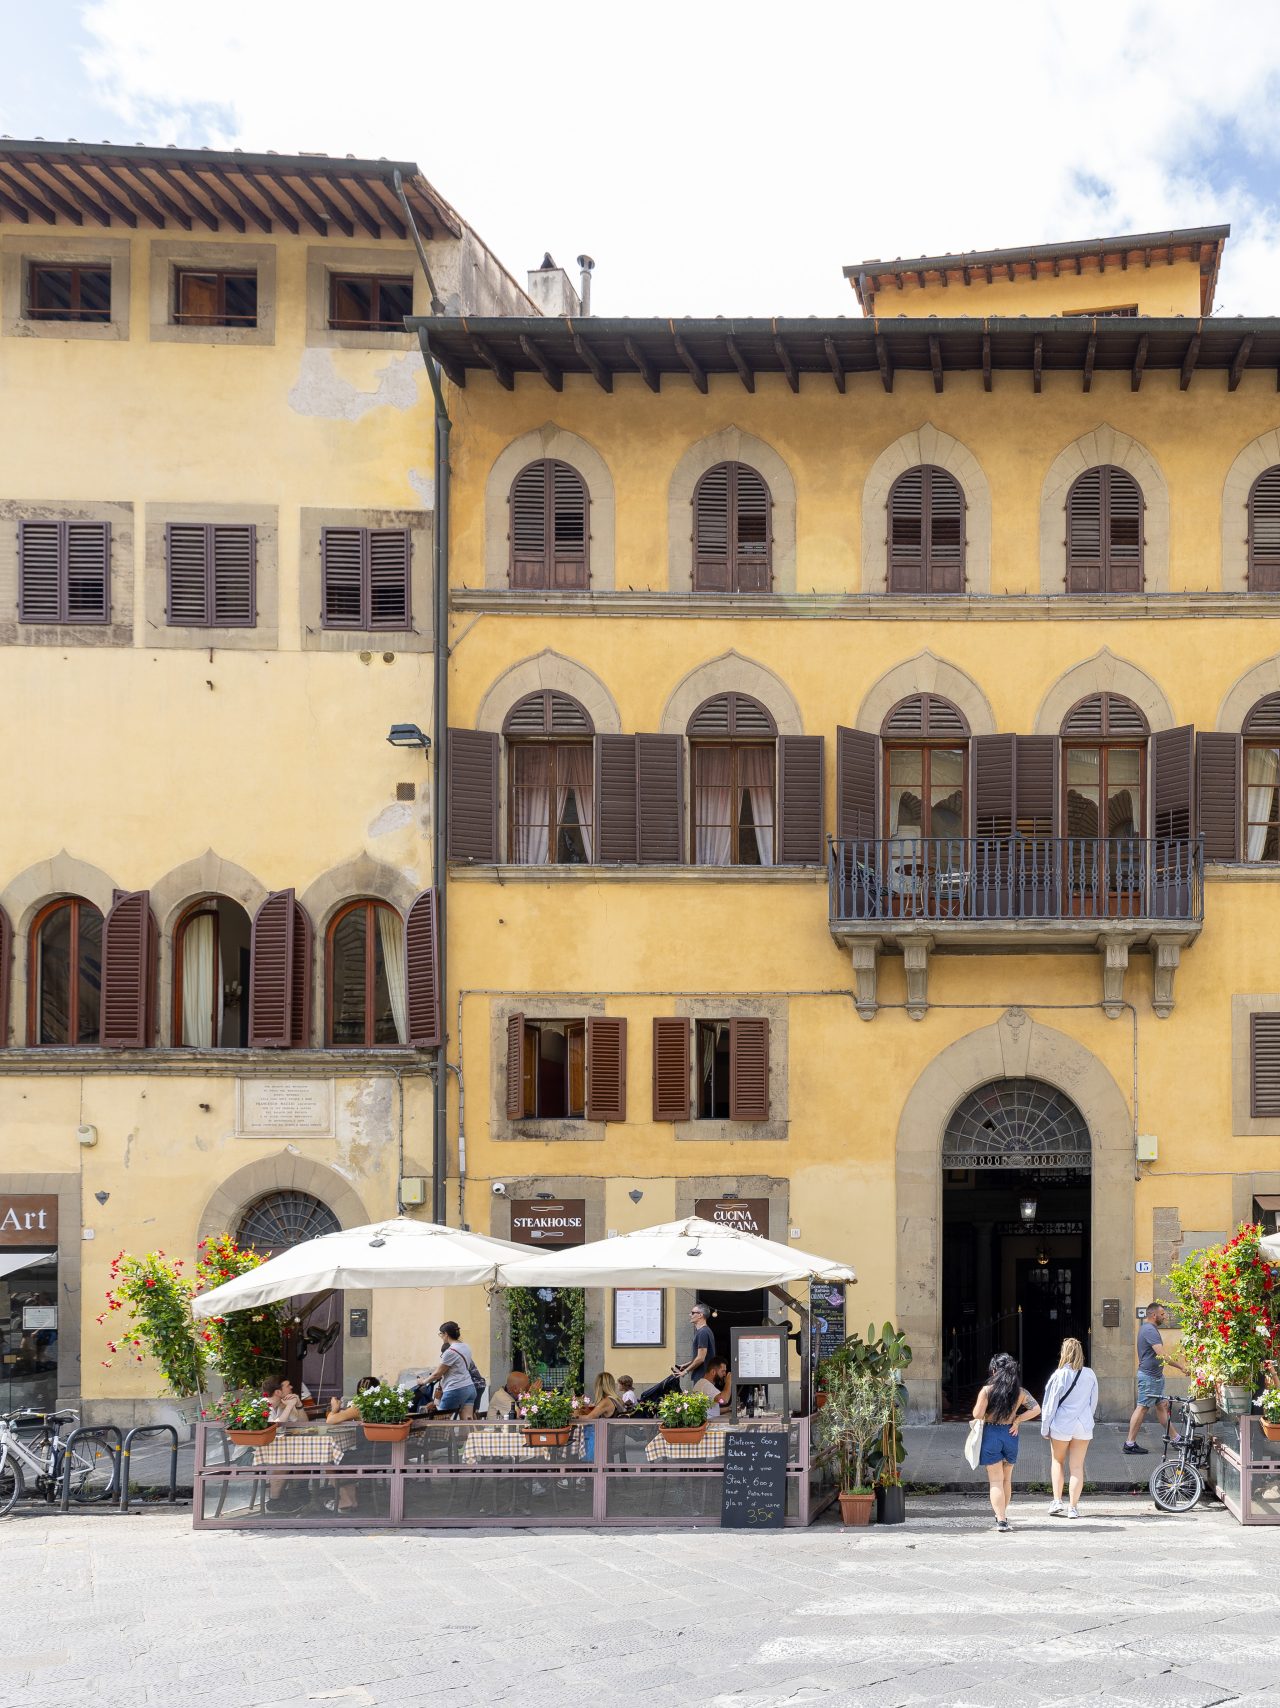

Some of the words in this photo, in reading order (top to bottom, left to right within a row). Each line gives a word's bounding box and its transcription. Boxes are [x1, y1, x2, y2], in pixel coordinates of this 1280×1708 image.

[0, 1207, 47, 1231] Art
[713, 1210, 752, 1221] CUCINA
[513, 1217, 582, 1228] STEAKHOUSE
